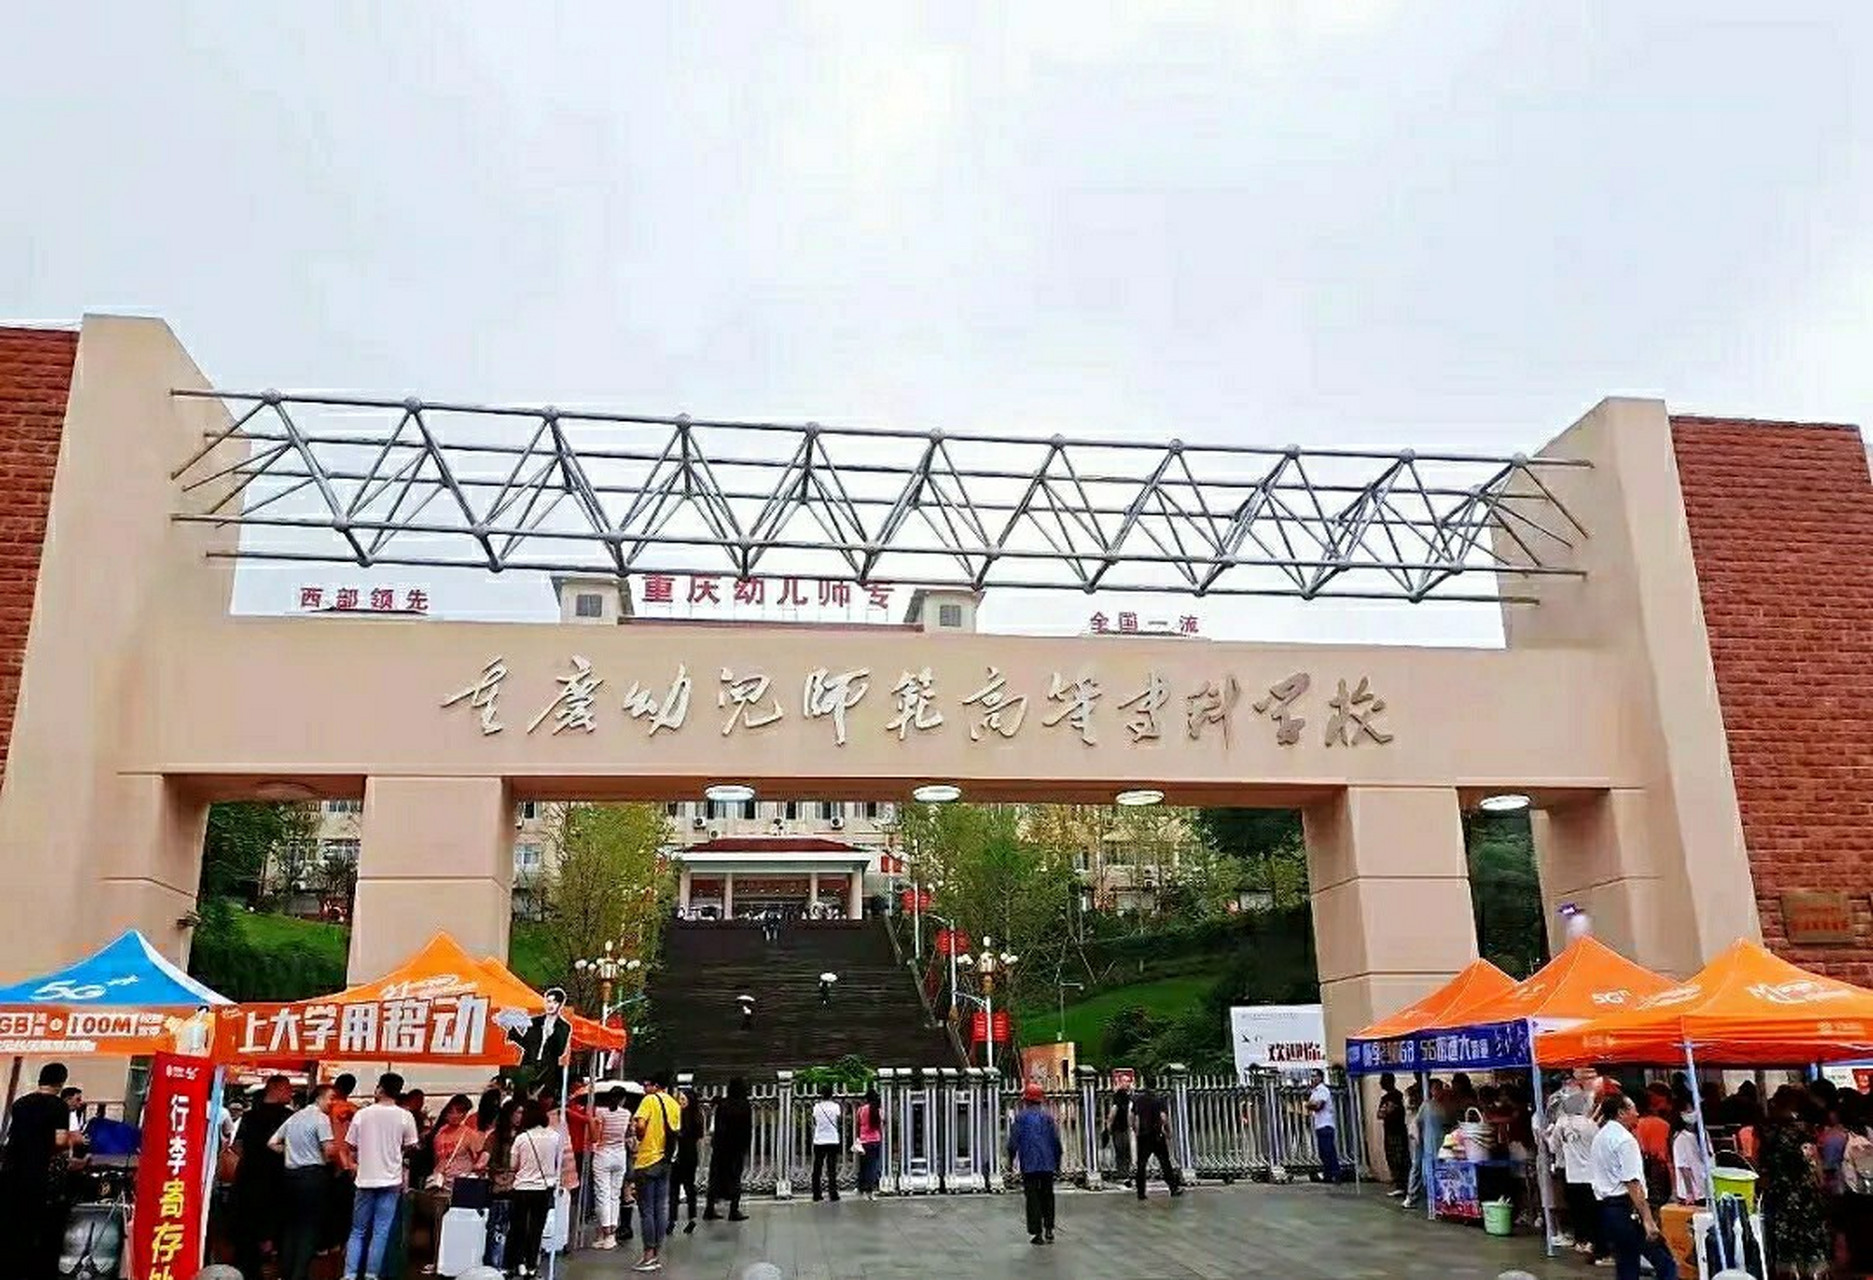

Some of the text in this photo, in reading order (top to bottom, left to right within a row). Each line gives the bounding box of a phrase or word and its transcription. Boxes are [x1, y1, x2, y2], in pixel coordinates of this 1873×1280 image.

[299, 586, 429, 611] 西部领先
[641, 573, 895, 609] 重庆幼儿师专
[1089, 611, 1200, 634] 全国一流
[71, 1016, 132, 1034] 100M
[238, 995, 491, 1055] 上大学用移动
